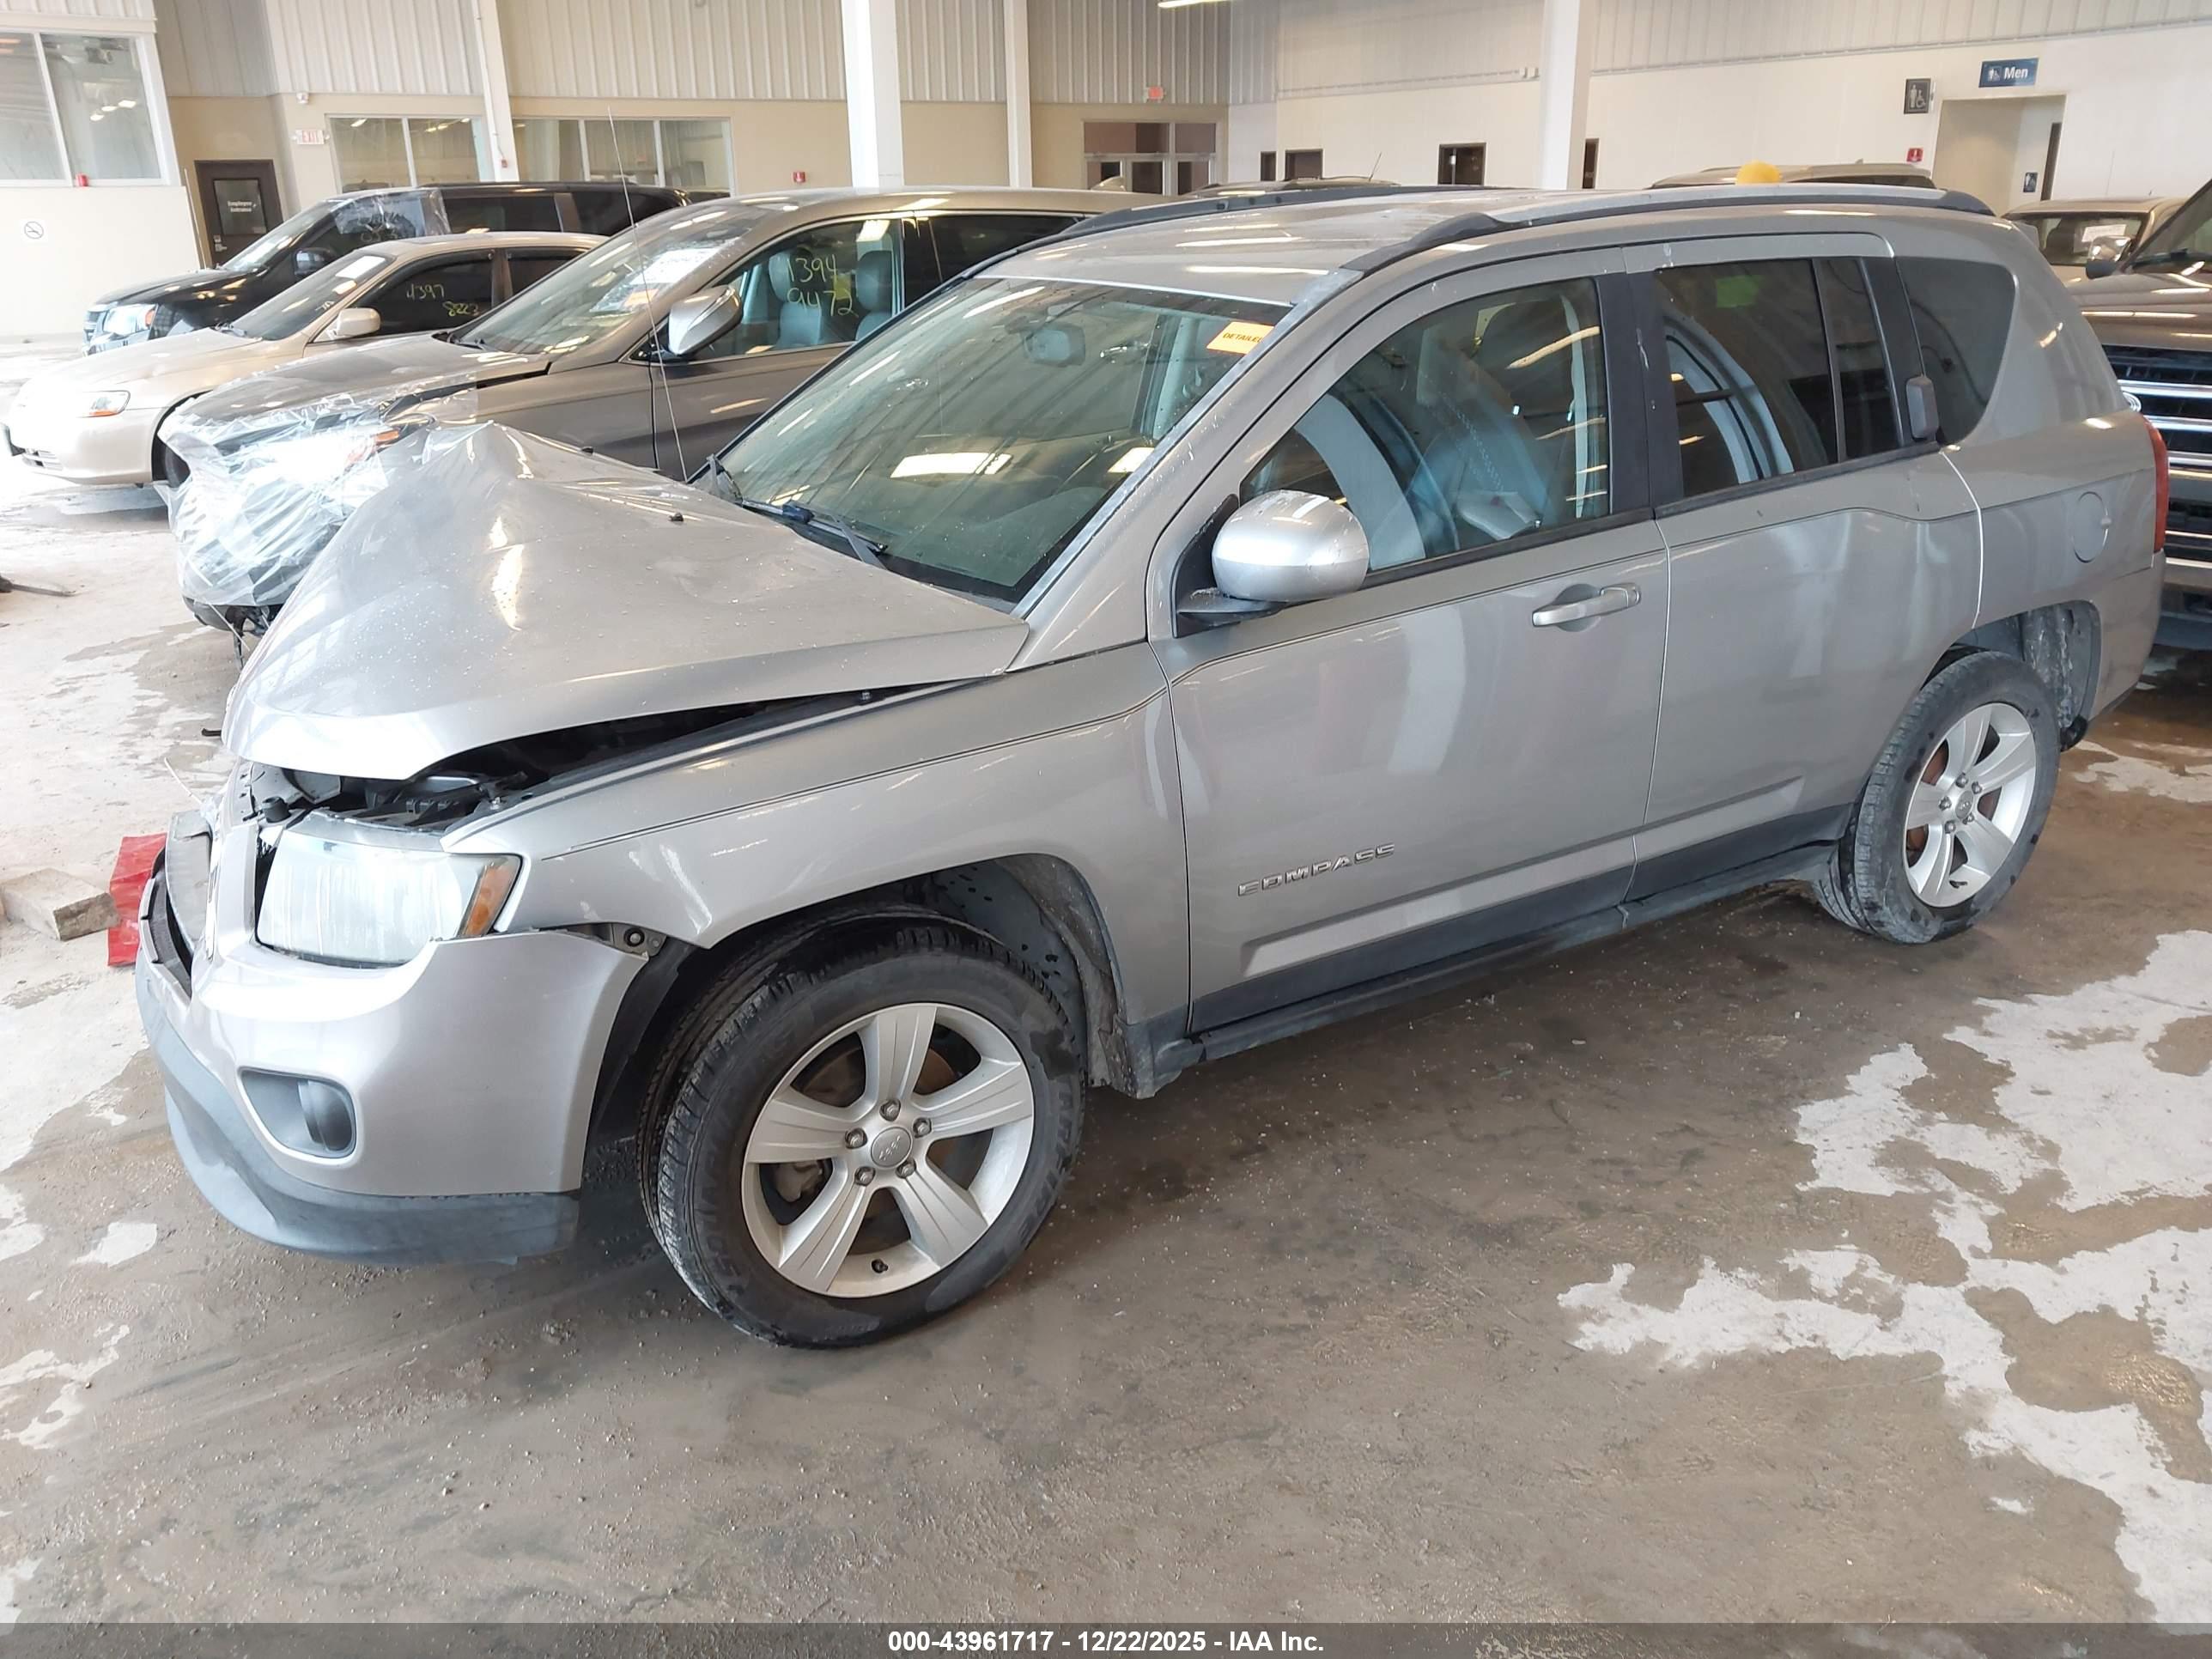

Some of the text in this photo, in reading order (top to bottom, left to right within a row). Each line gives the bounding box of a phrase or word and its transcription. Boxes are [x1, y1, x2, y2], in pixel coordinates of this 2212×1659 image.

[2003, 66, 2028, 80] Men
[787, 288, 860, 317] 9472
[1237, 843, 1395, 897] COMPASS
